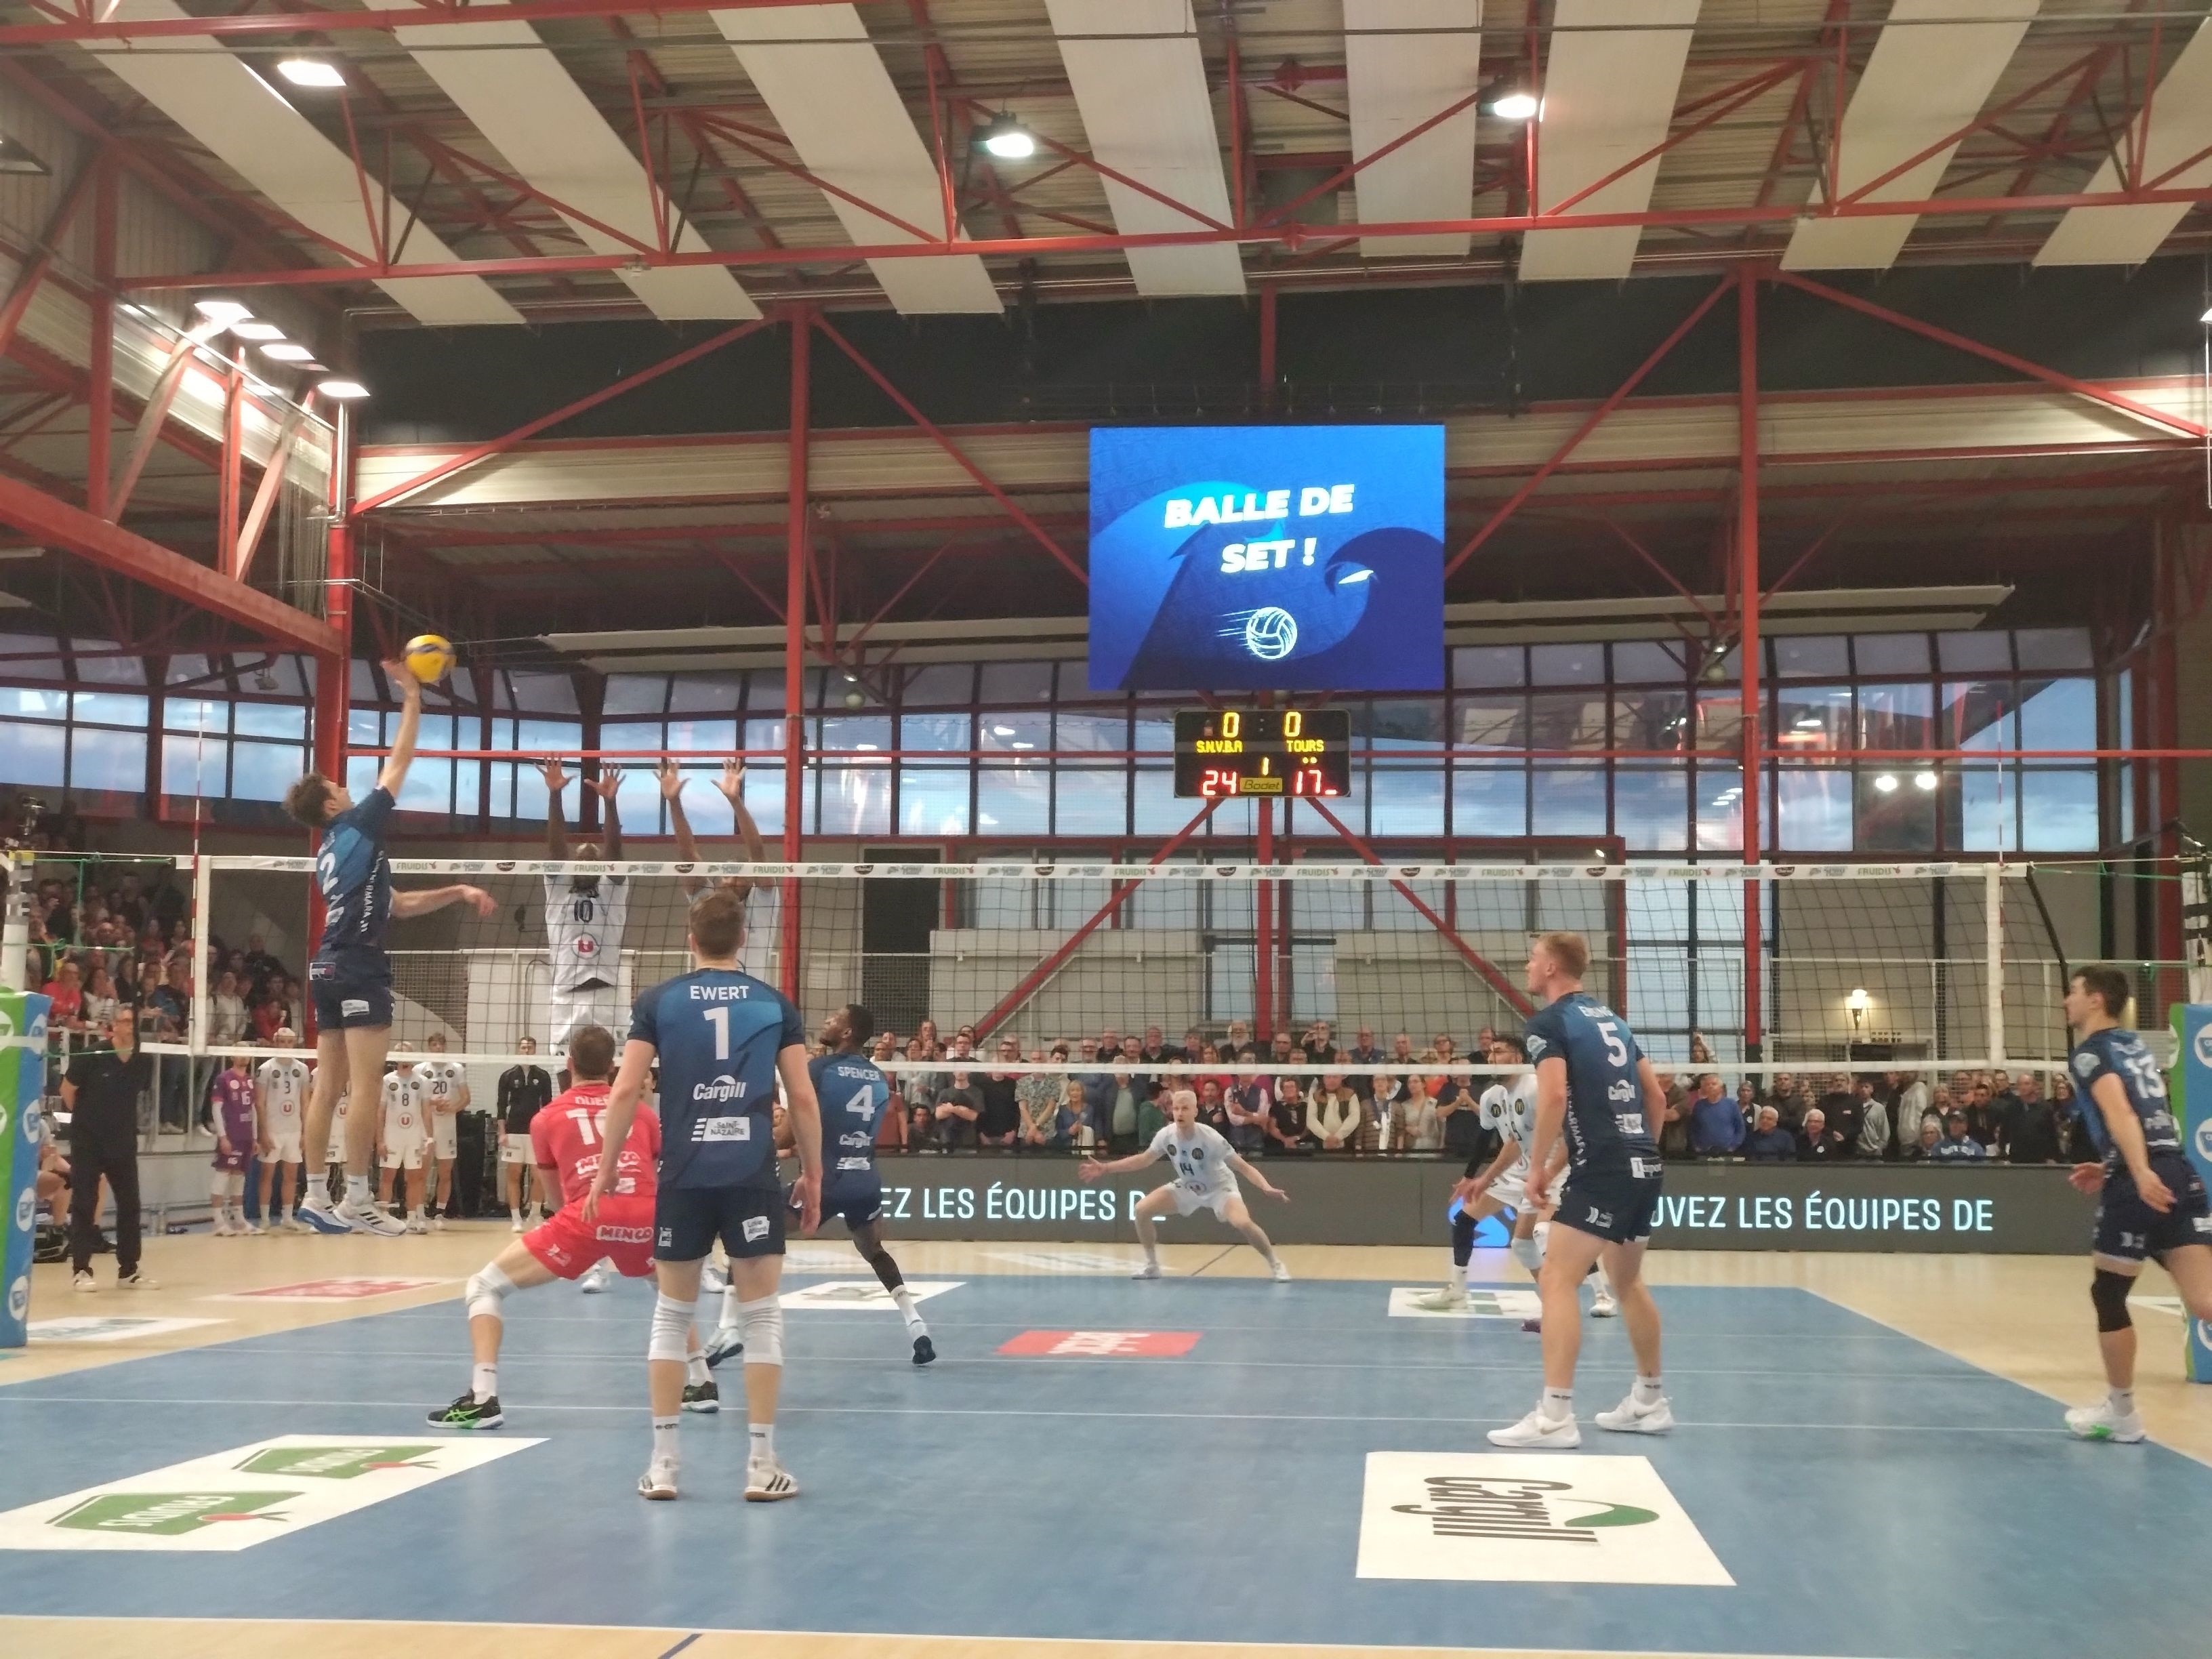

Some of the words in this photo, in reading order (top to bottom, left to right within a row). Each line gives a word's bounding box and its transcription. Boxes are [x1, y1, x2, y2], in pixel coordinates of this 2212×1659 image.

[1164, 489, 1291, 529] BALLE
[1299, 483, 1355, 516] DE
[1221, 539, 1296, 573] SET
[1303, 537, 1317, 567] !
[1223, 712, 1240, 738] 0
[1284, 712, 1302, 737] 0
[1286, 739, 1325, 753] TOURS
[1261, 756, 1270, 776] 1
[1202, 769, 1237, 796] 24
[1242, 779, 1280, 791] Bodet
[319, 852, 339, 895] 2
[396, 862, 428, 871] FRUIDIS
[573, 863, 607, 872] FRUIDIS
[752, 865, 785, 874] FRUIDIS
[573, 899, 594, 923] 10
[689, 985, 750, 1000] EWERT
[703, 1006, 730, 1061] 1
[1597, 1021, 1627, 1068] 5
[837, 1066, 881, 1082] SPENCER
[2123, 1053, 2167, 1099] 13
[284, 1080, 291, 1094] 3
[432, 1081, 447, 1094] 20
[693, 1081, 747, 1103] Cargill
[401, 1092, 409, 1107] 8
[575, 1095, 613, 1107] DUE
[845, 1084, 876, 1122] 4
[710, 1127, 745, 1136] NAZAIRE
[1179, 1162, 1195, 1176] 14
[880, 1187, 912, 1219] EZ
[923, 1187, 975, 1219] LES
[987, 1181, 1116, 1221] ÉQUIPES
[1650, 1195, 1727, 1229] UVEZ
[1738, 1197, 1793, 1229] LES
[1805, 1191, 1942, 1232] ÉQUIPES
[1954, 1200, 1994, 1231] DE
[598, 1226, 654, 1243] MENCO
[1390, 1476, 1599, 1543] Cargill
